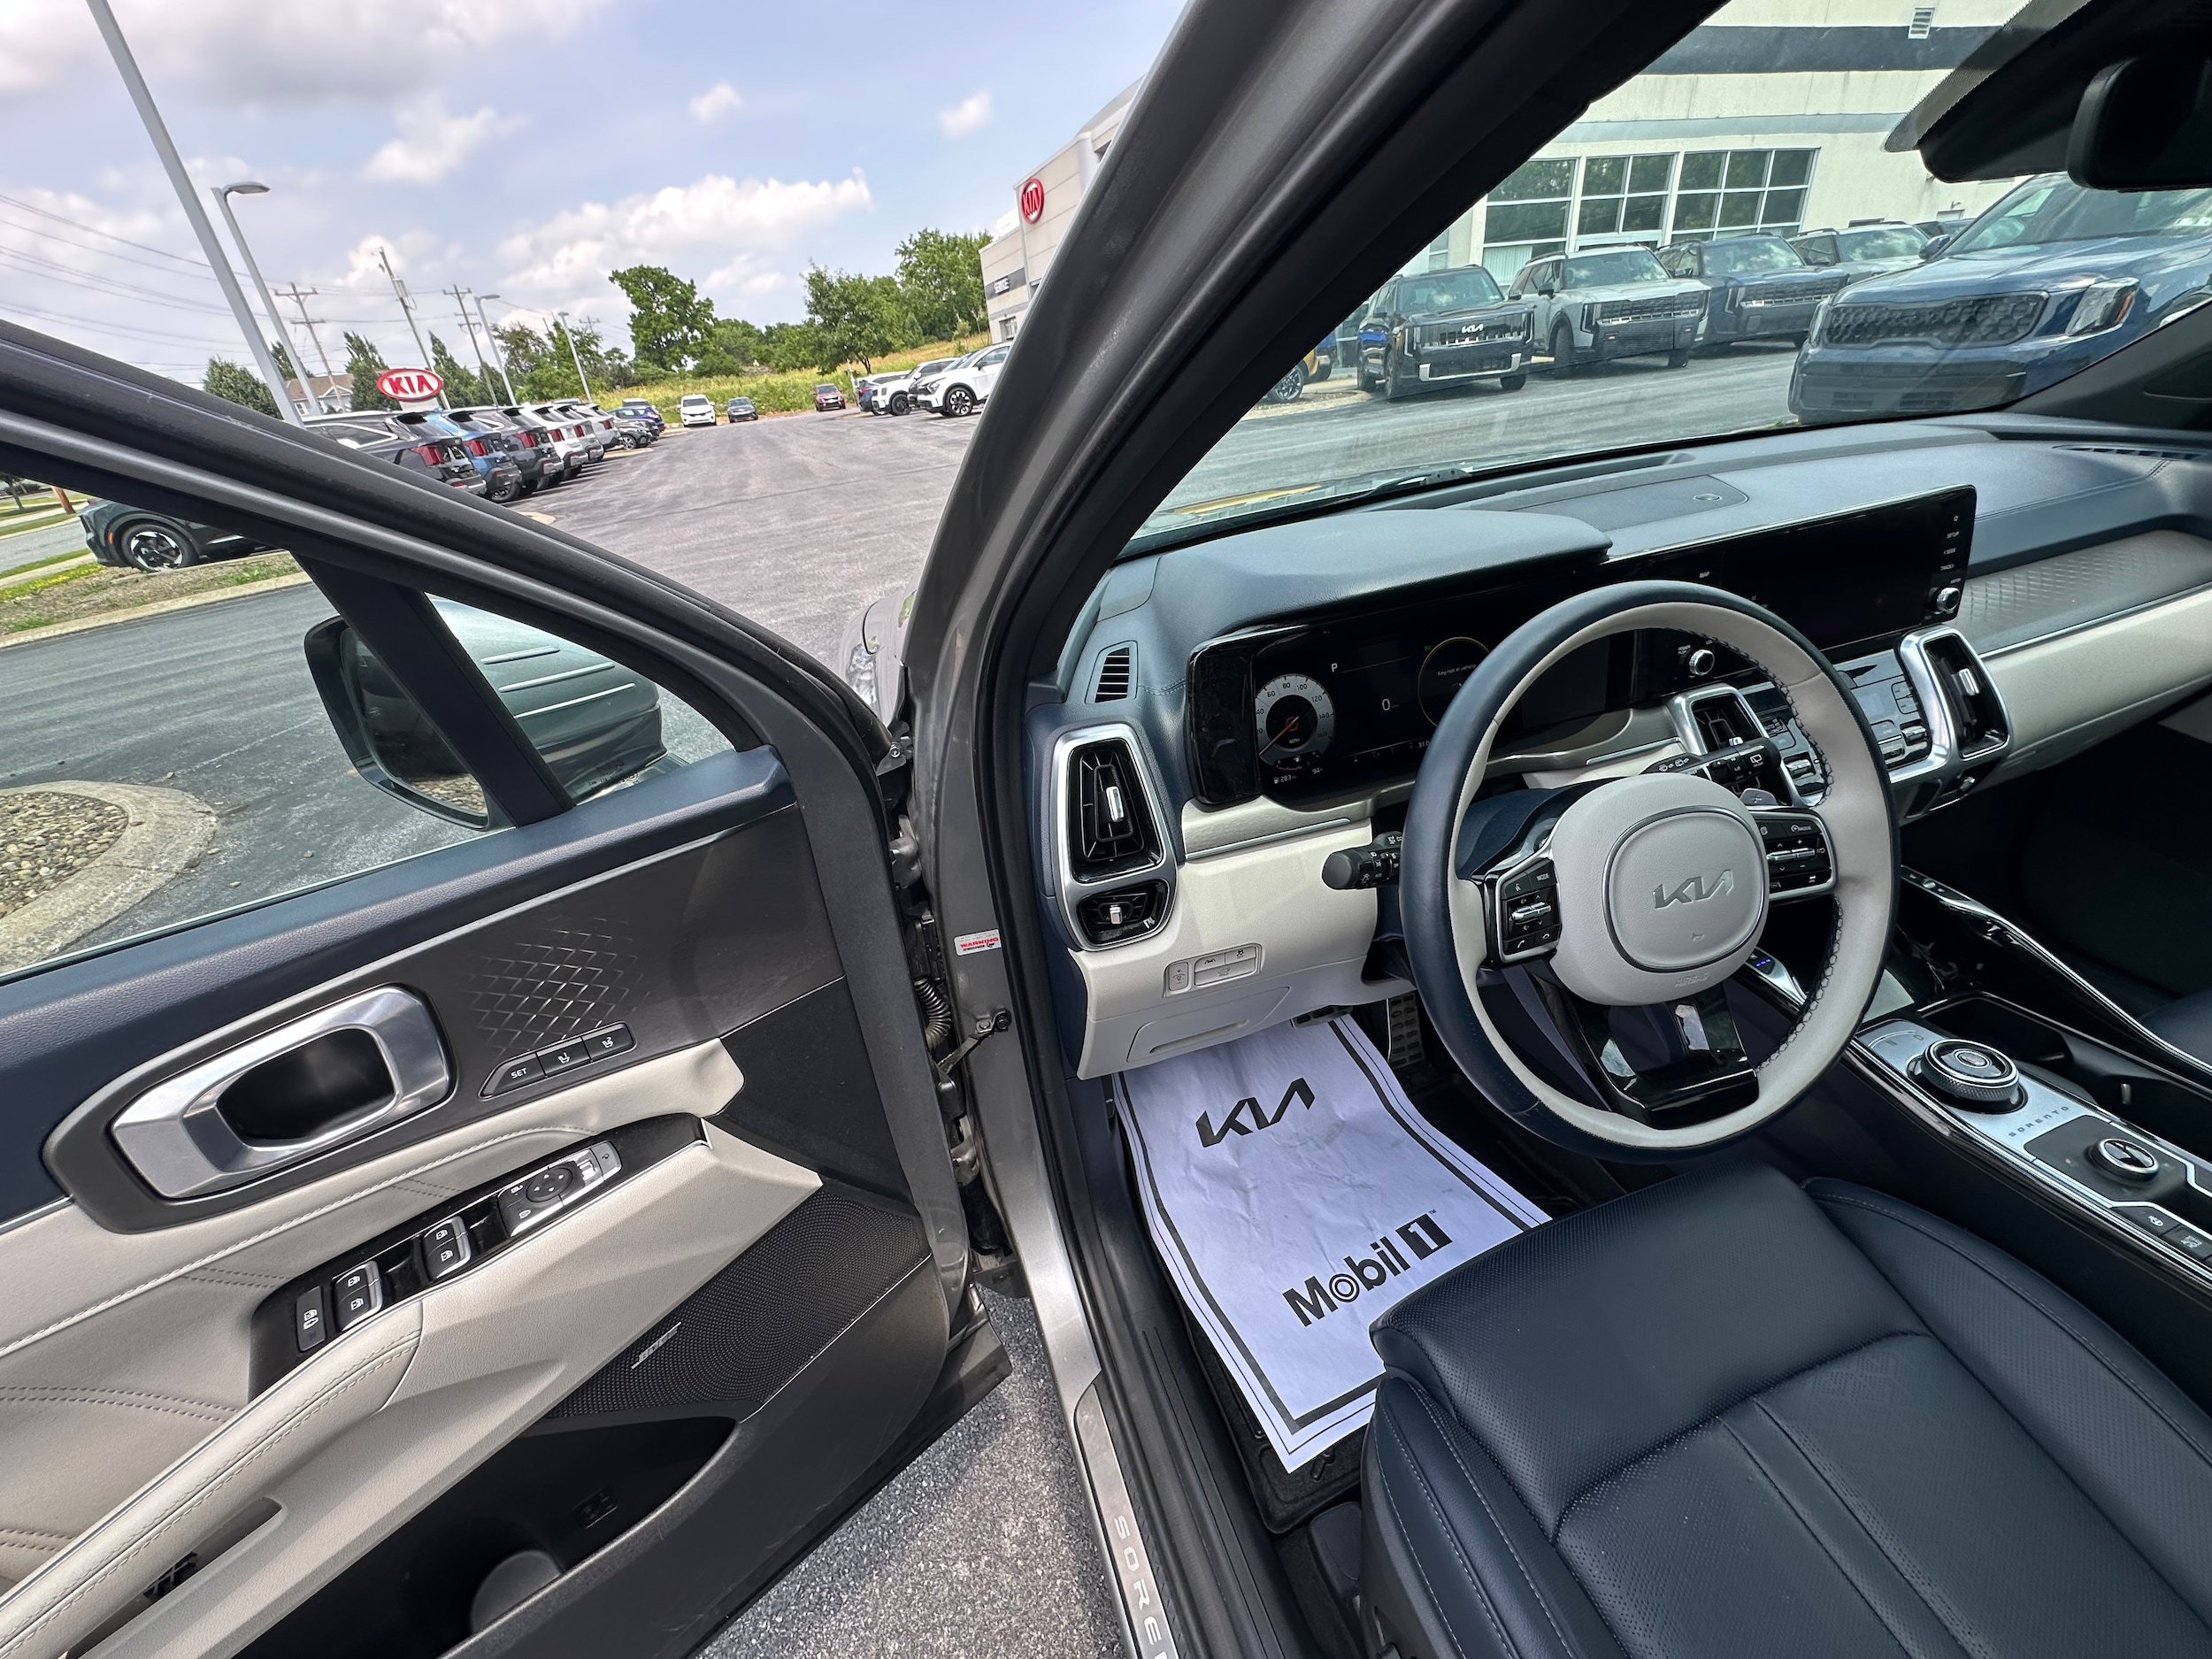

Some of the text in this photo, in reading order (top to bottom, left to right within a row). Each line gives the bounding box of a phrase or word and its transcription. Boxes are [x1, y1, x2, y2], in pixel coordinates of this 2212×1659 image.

[1022, 187, 1041, 217] KIA
[1461, 323, 1484, 334] KIA
[386, 374, 435, 395] KIA
[1331, 663, 1338, 672] P
[1381, 698, 1391, 711] 0
[1652, 868, 1734, 910] KIA
[960, 937, 999, 949] WARNING
[511, 1067, 527, 1079] SET
[1195, 1077, 1316, 1148] KIA
[2008, 1105, 2070, 1137] SORENTO
[1282, 1236, 1411, 1327] Mobil
[1114, 1515, 1169, 1659] SORE
